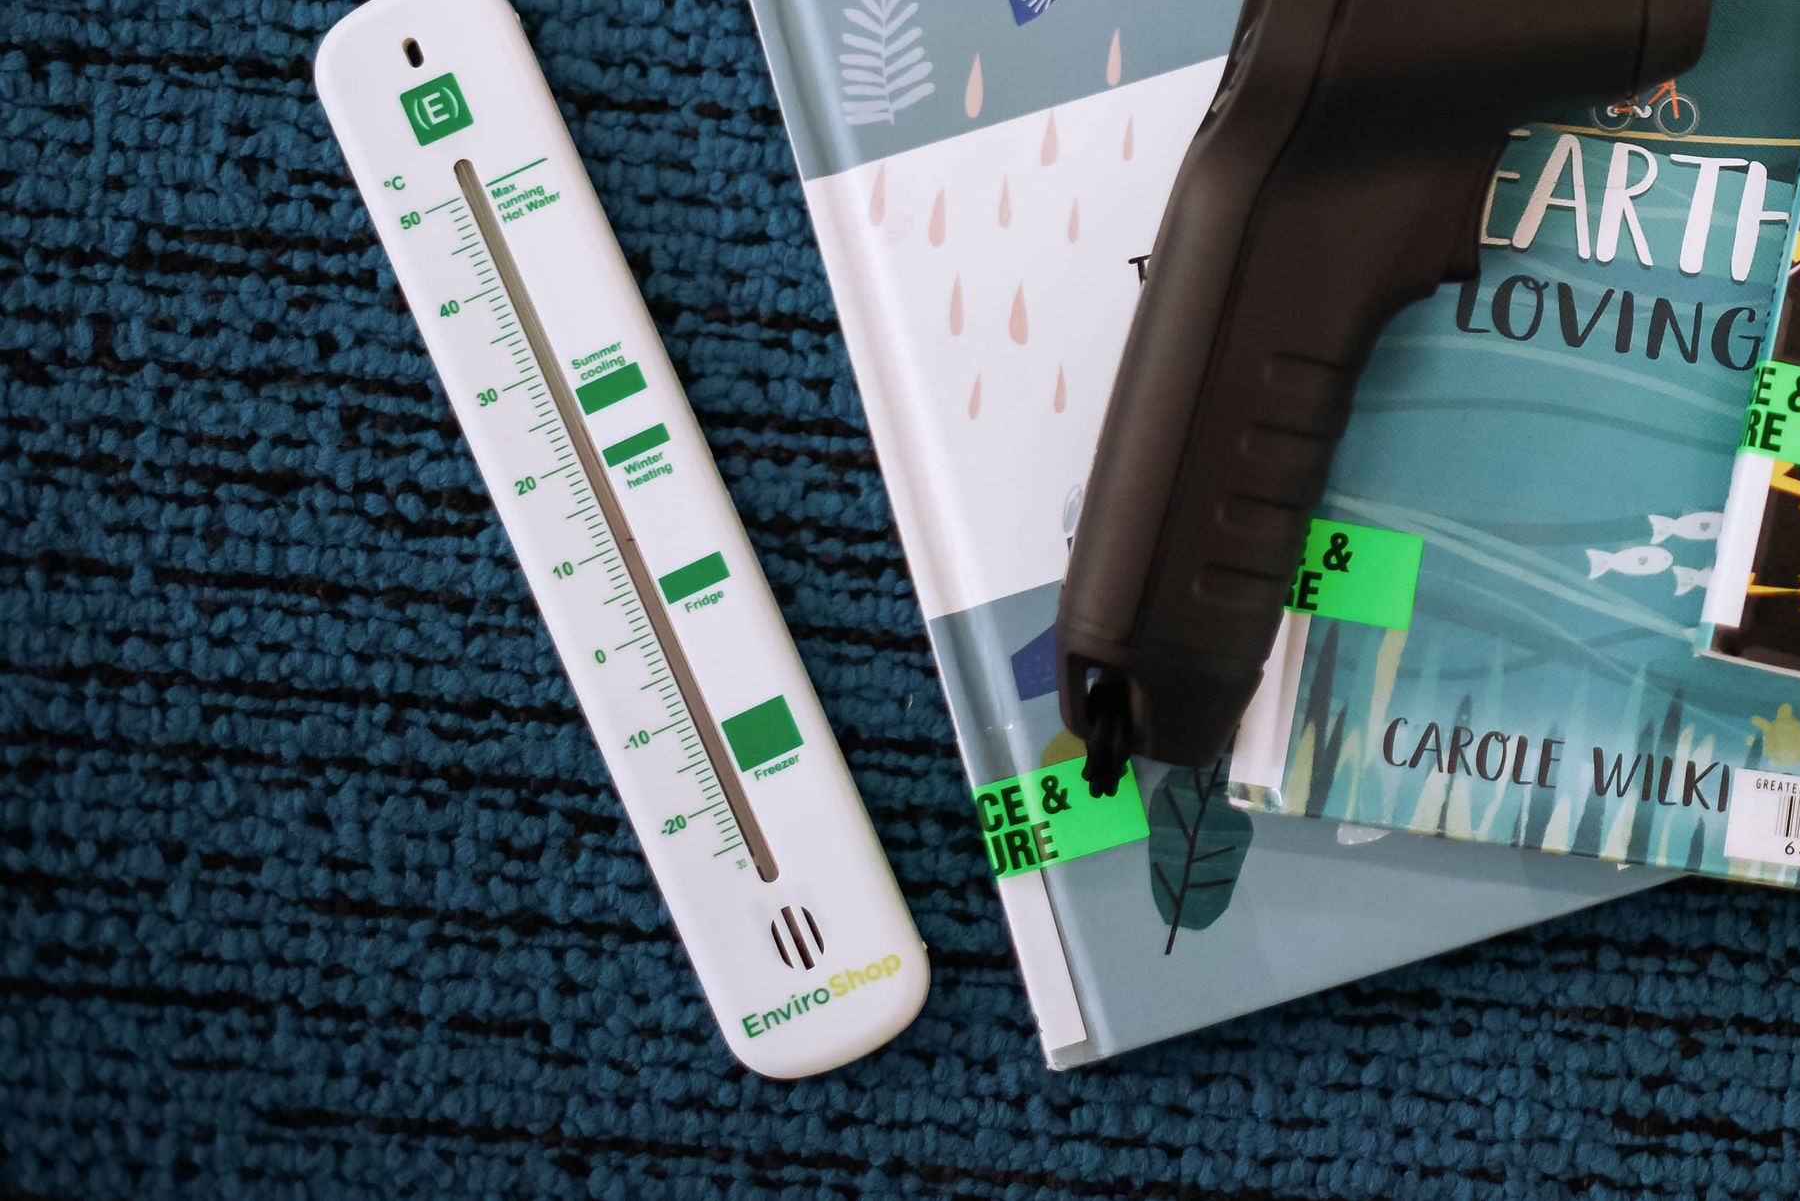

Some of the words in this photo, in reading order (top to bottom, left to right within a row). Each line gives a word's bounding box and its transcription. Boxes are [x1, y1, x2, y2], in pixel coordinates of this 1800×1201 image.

[491, 183, 517, 199] Max
[497, 185, 545, 211] running
[502, 208, 524, 224] Hot
[525, 191, 560, 212] Water
[400, 211, 421, 230] 50
[440, 299, 460, 318] 40
[1456, 275, 1765, 370] LOVING
[571, 341, 622, 370] Summer
[580, 355, 627, 381] cooling
[476, 388, 499, 407] 30
[624, 451, 664, 475] Winter
[515, 476, 537, 496] 20
[627, 463, 673, 489] heating
[1322, 532, 1353, 573] &
[553, 561, 574, 579] 10
[685, 589, 724, 614] Fridge
[595, 649, 606, 665] 0
[623, 730, 650, 751] -10
[754, 753, 800, 782] Freezer
[1383, 717, 1565, 788] CAROLE
[1593, 746, 1730, 812] WILKI
[1041, 775, 1072, 814] &
[661, 815, 687, 836] -20
[742, 952, 902, 1039] EnviroShop
